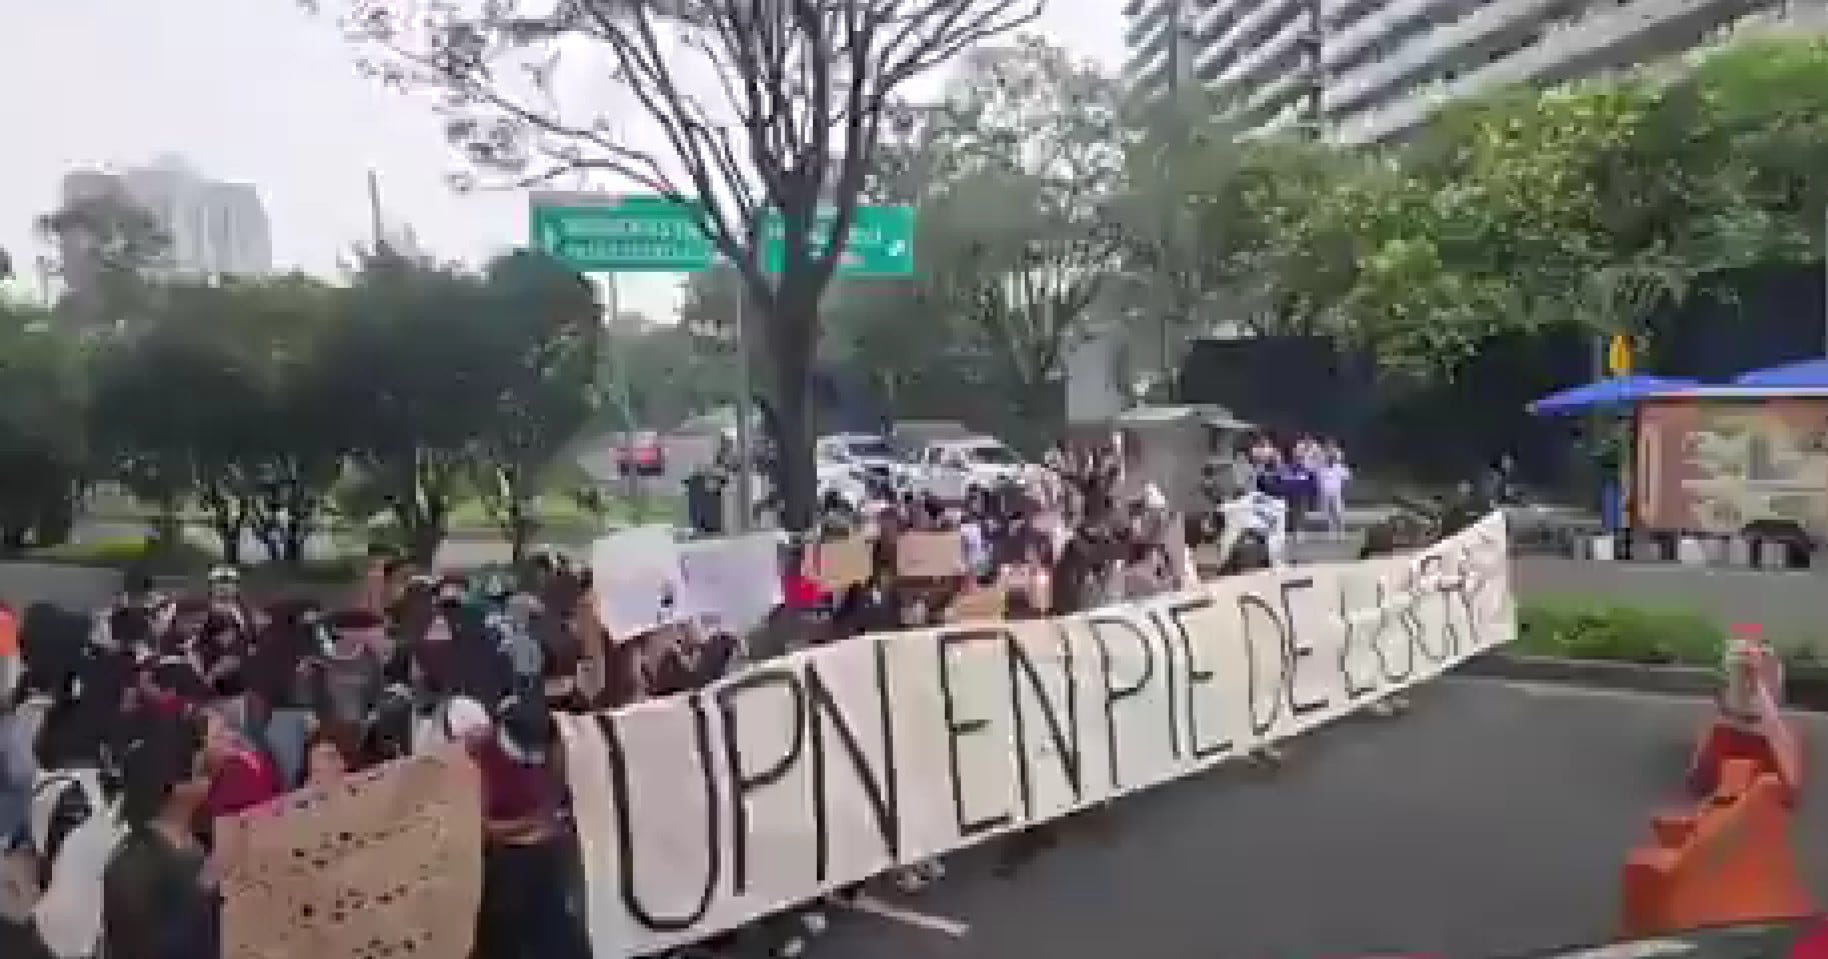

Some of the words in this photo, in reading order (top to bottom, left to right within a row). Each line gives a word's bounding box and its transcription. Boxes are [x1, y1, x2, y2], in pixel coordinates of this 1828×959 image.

[595, 640, 898, 930] UPN
[938, 631, 1082, 836] EN
[1089, 599, 1233, 788] PIE
[1237, 579, 1329, 735] DE
